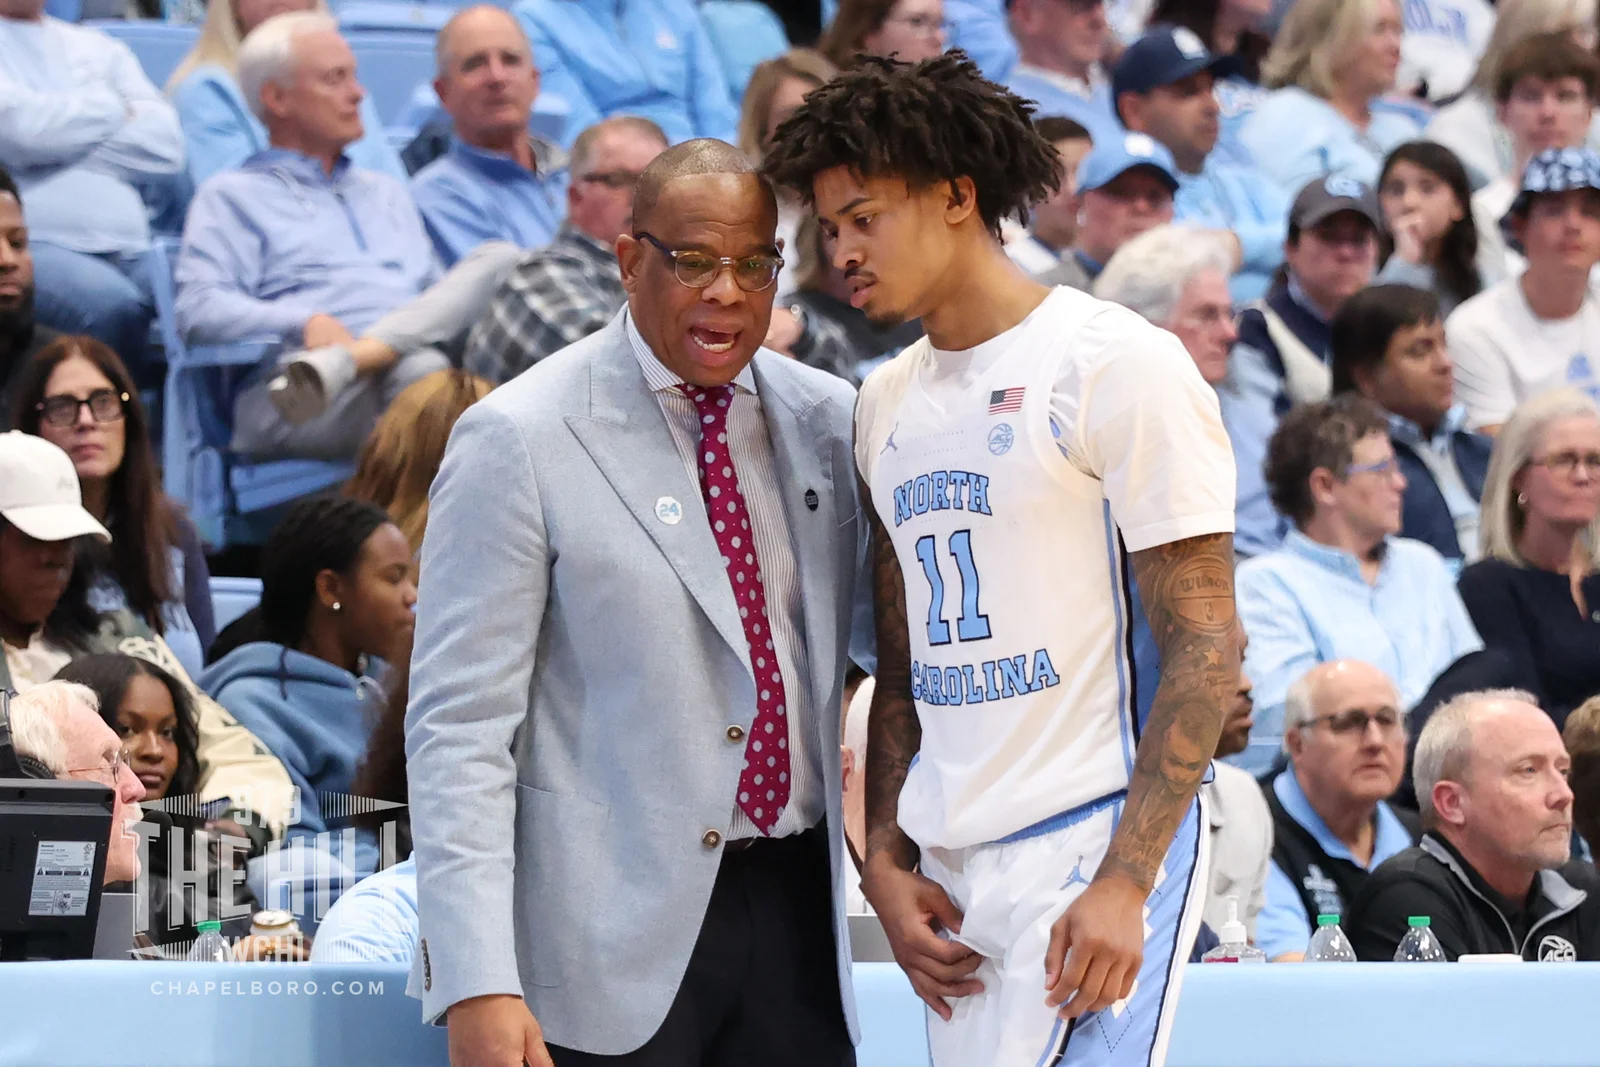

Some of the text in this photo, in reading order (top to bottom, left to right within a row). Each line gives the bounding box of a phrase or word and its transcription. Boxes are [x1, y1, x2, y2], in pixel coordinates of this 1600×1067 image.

[659, 503, 679, 517] 24
[894, 470, 993, 527] NORTH
[915, 529, 992, 646] 11
[911, 648, 1060, 706] CAROLINA
